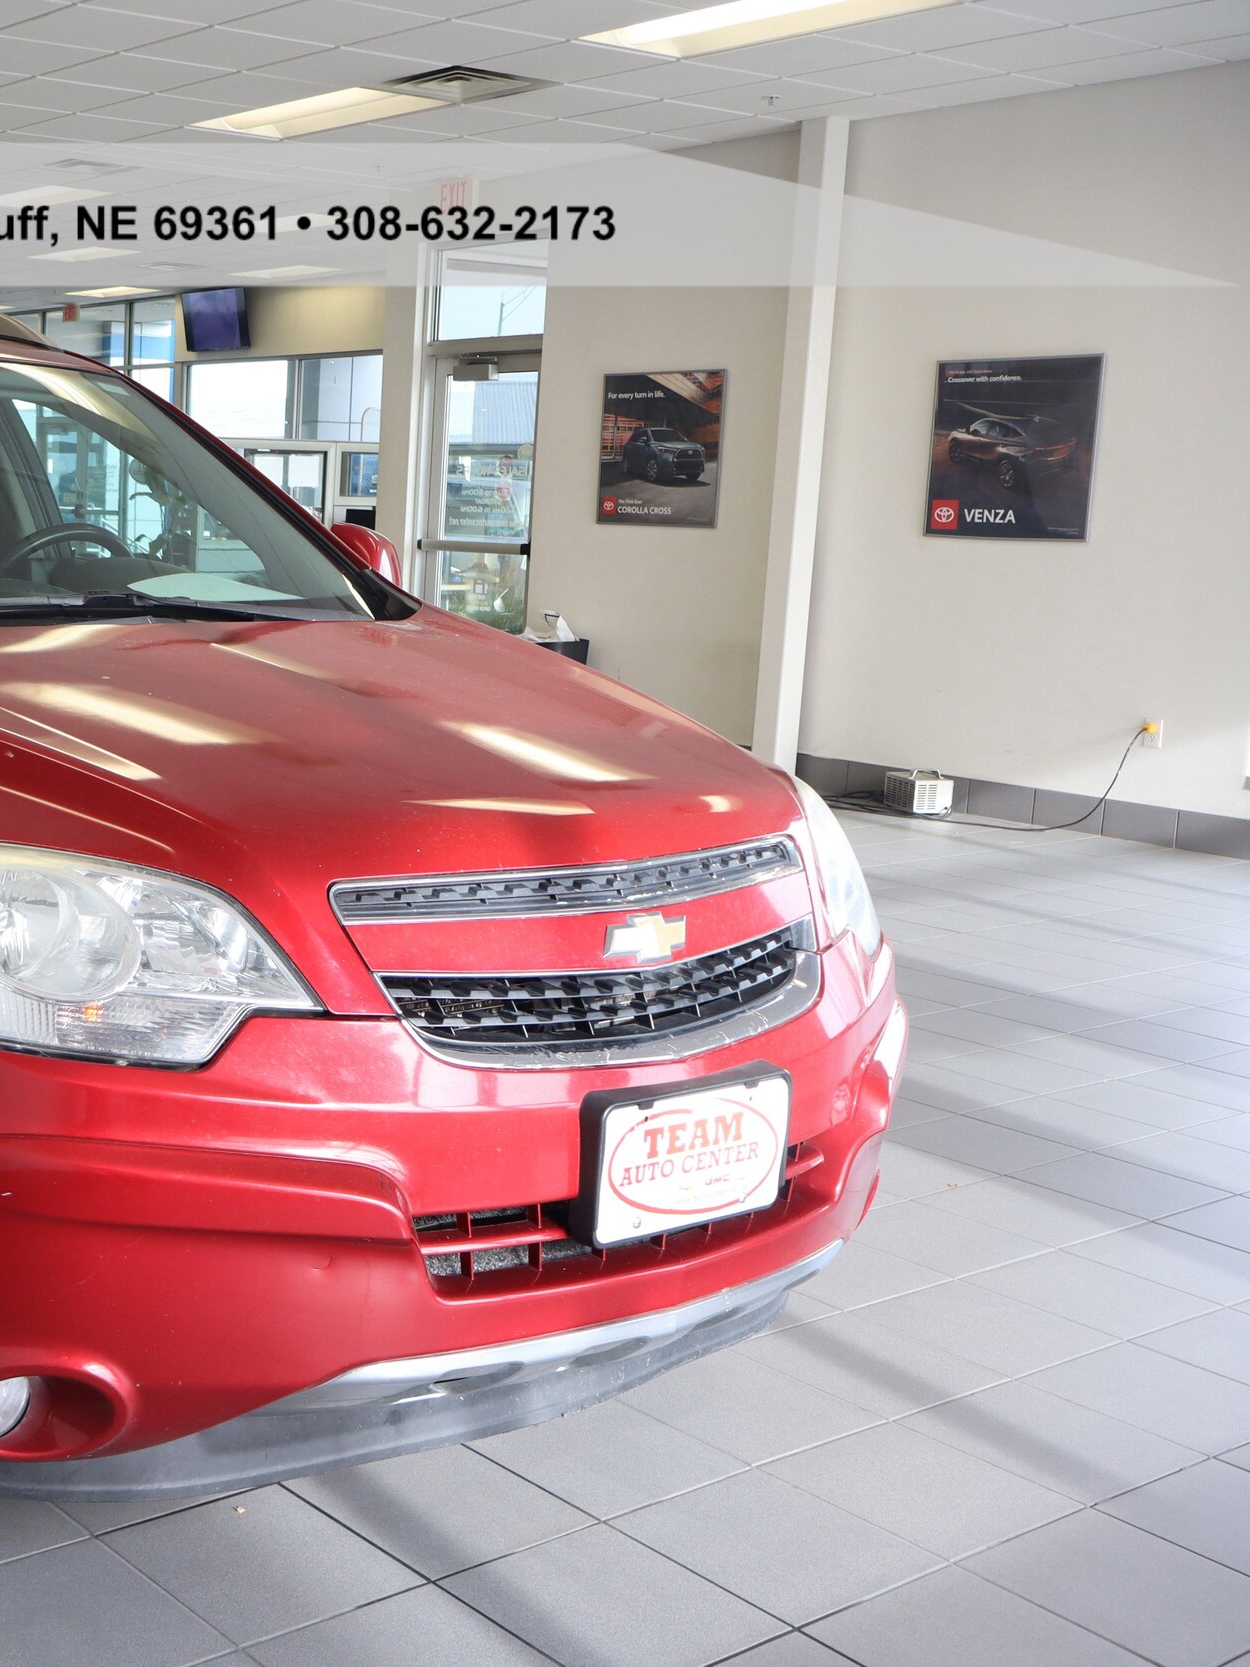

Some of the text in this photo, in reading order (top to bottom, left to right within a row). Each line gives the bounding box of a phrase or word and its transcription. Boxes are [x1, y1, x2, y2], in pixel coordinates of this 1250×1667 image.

[439, 180, 468, 214] EXIT
[618, 392, 634, 400] every
[635, 391, 647, 399] turn
[648, 390, 654, 398] in
[654, 390, 665, 398] life.
[617, 505, 672, 515] COROLLA CROSS
[964, 508, 1017, 524] VENZA
[644, 1111, 743, 1159] TEAM
[618, 1141, 759, 1187] AUTO CENTER
